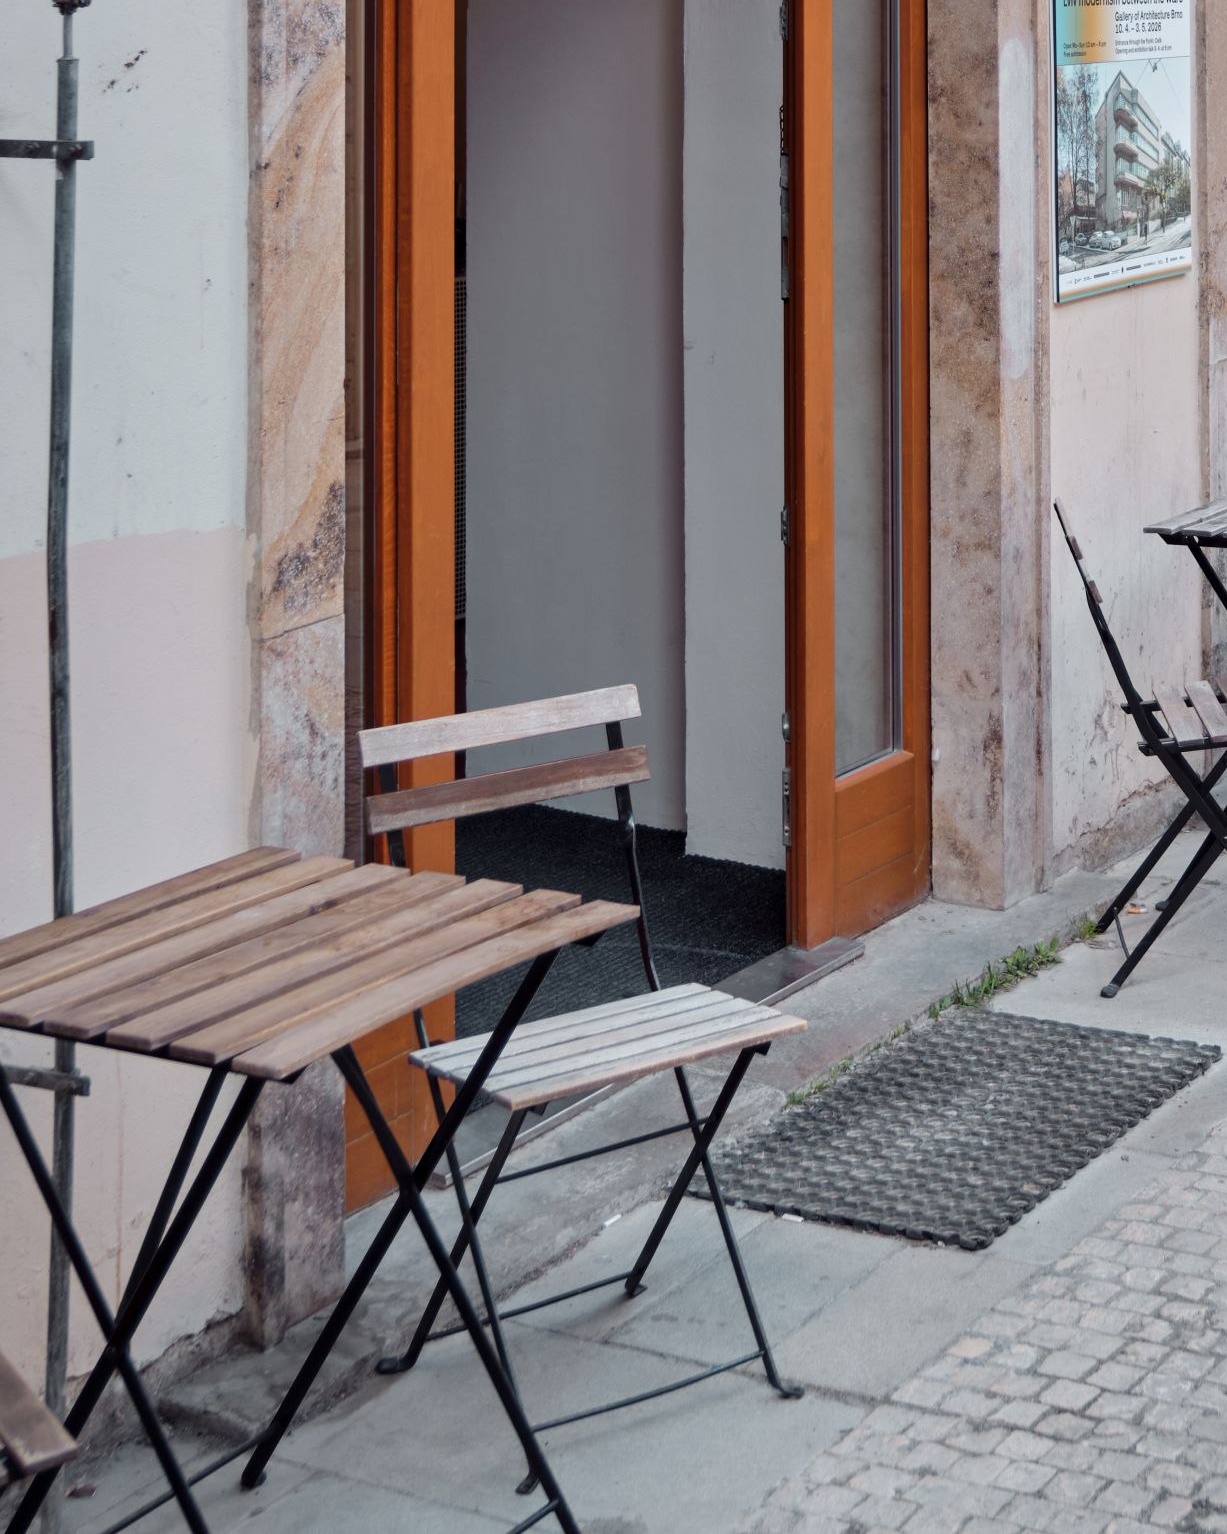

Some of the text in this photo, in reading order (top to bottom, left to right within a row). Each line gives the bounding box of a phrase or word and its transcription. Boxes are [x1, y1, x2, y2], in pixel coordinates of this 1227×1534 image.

[1114, 9, 1183, 23] Gallery of Architecture Brno
[1115, 23, 1123, 34] 10.
[1124, 23, 1130, 33] 4.
[1135, 22, 1141, 33] 3.
[1147, 21, 1162, 32] 2026
